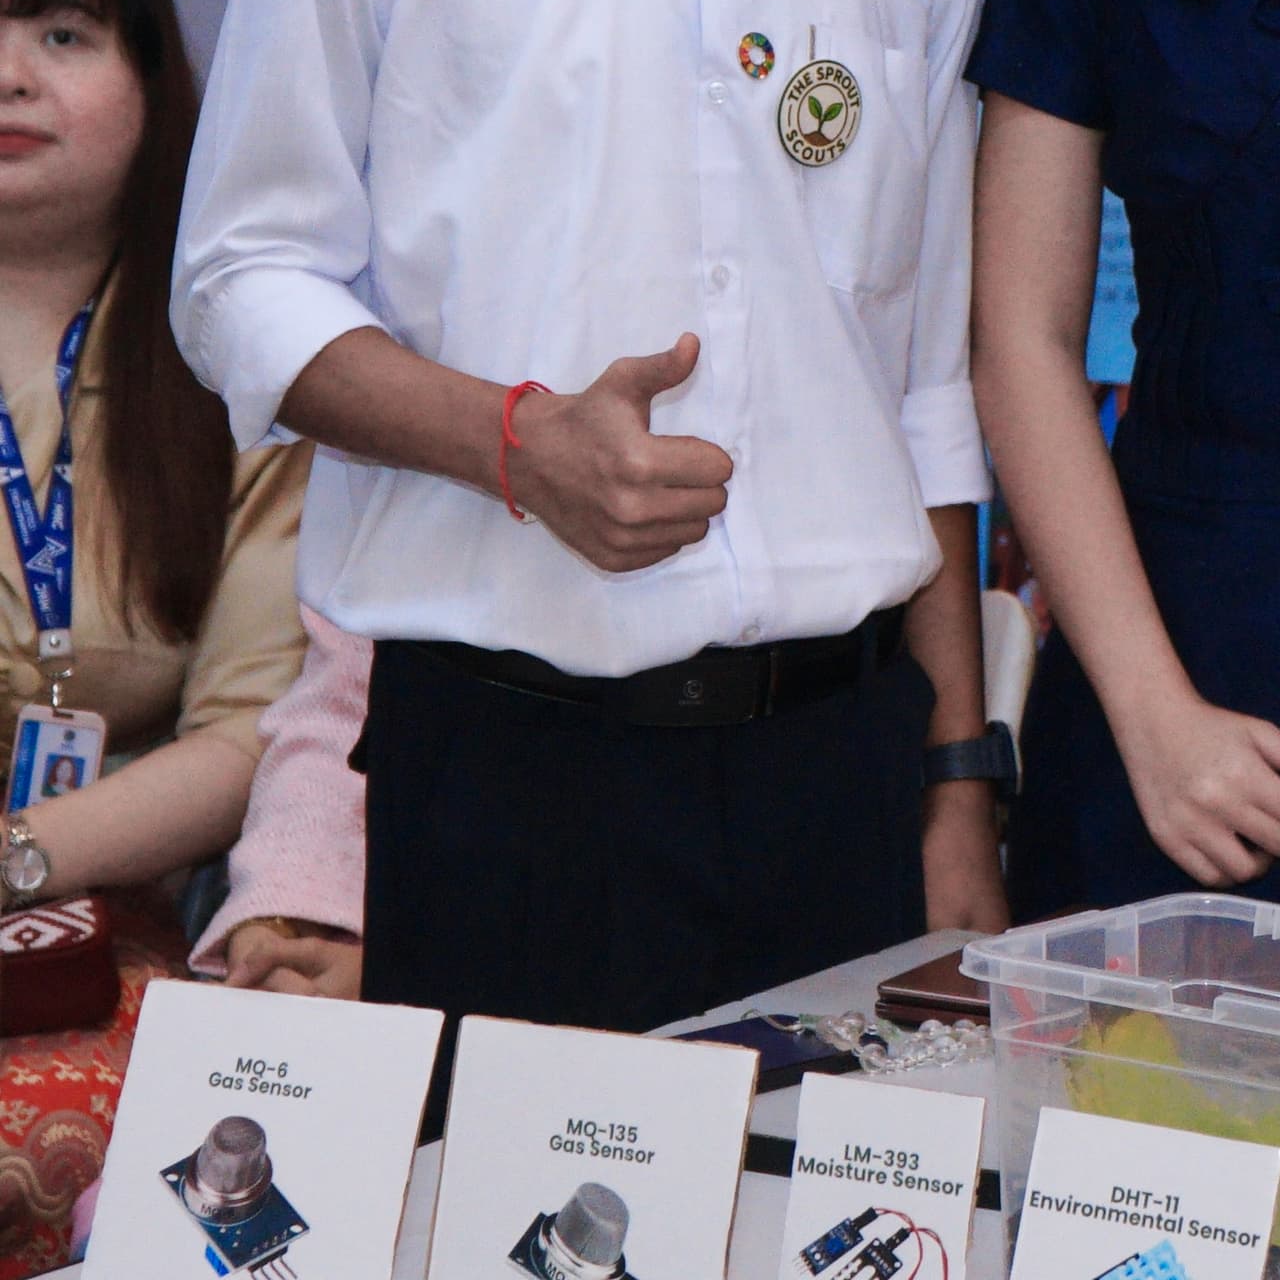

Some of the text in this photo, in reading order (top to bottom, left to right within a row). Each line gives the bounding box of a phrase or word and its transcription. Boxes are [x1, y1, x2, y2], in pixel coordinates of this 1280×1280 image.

[787, 66, 861, 108] THE SPROUT
[786, 128, 846, 163] SCOUTS
[235, 1056, 288, 1080] MQ-6
[208, 1071, 313, 1101] Gas Sensor
[566, 1117, 639, 1145] MQ-135
[549, 1134, 656, 1166] Gas Sensor
[843, 1143, 920, 1172] LM-393
[798, 1156, 964, 1197] Moisture Sensor
[1110, 1185, 1180, 1214] DHT-11
[1029, 1190, 1261, 1249] Environmental Sensor
